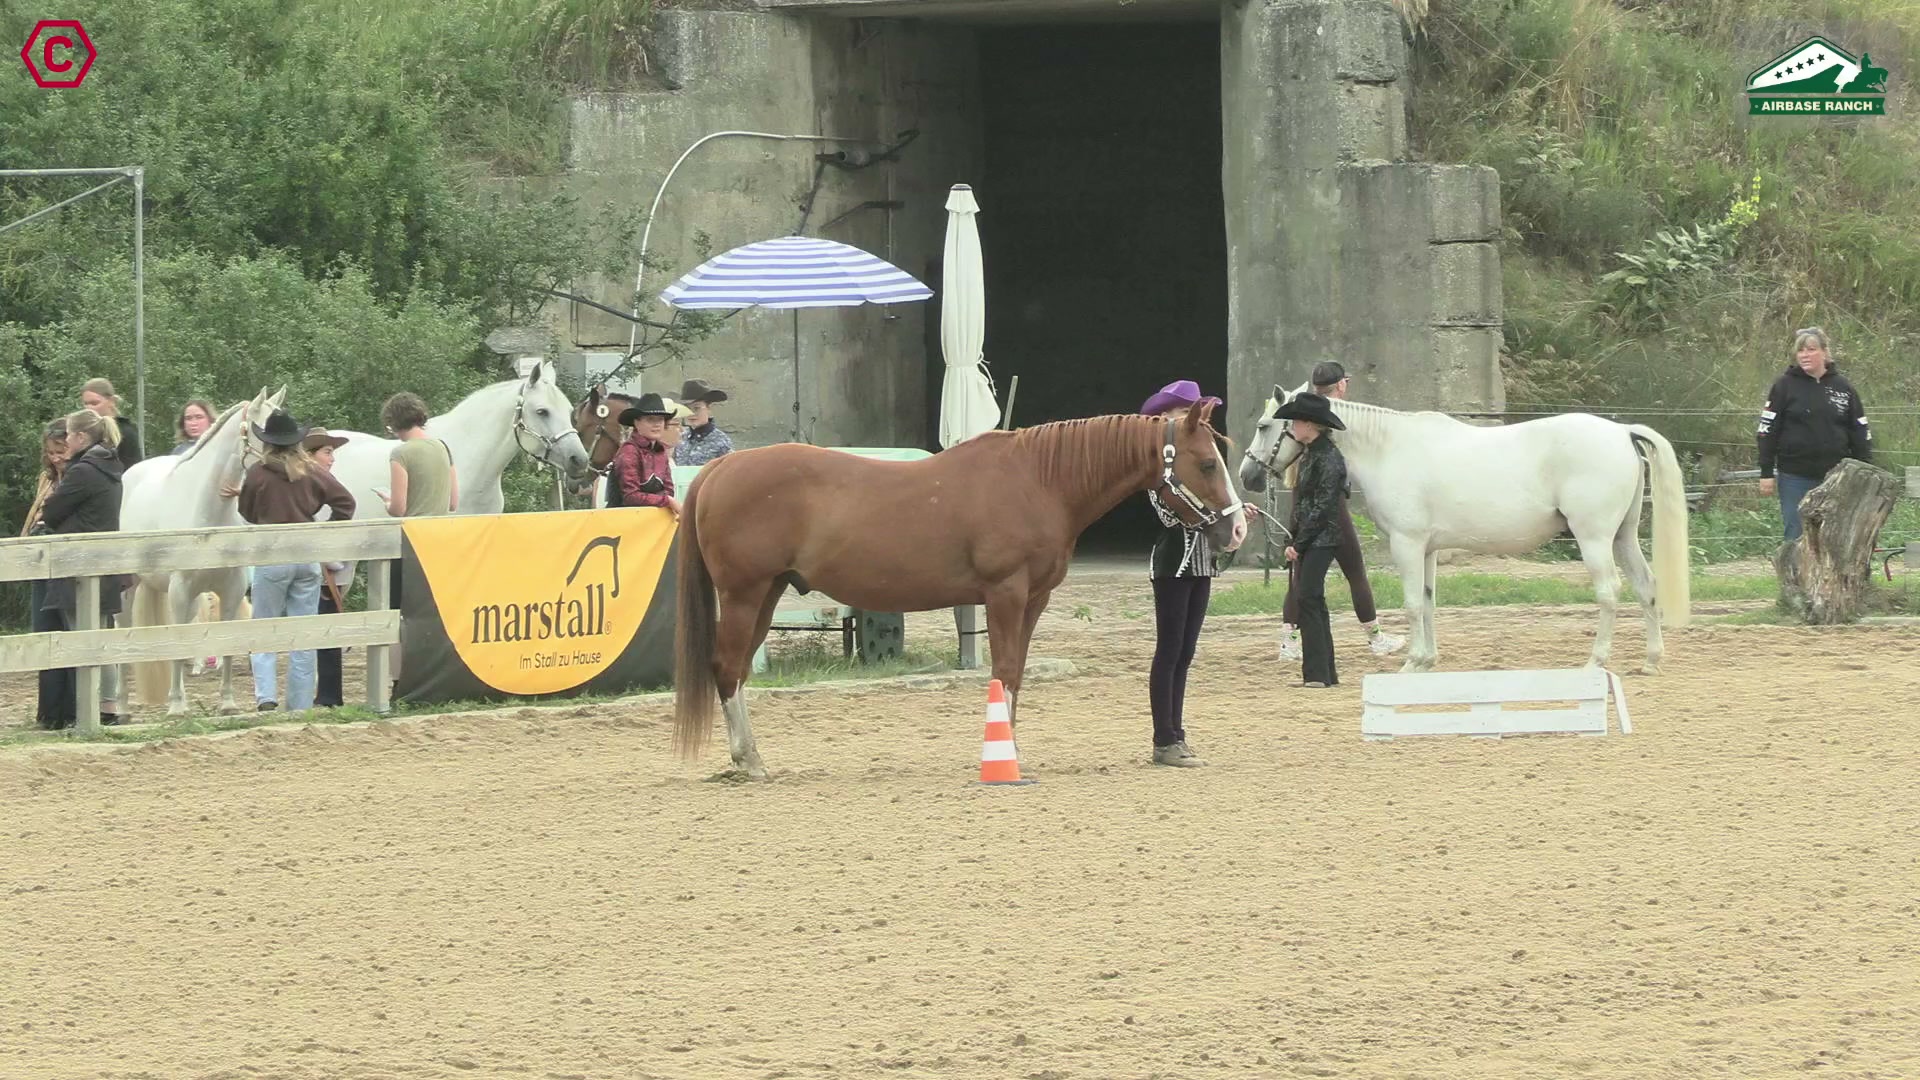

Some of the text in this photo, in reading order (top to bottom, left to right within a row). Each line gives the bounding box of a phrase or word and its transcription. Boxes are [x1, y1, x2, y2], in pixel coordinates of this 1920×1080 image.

[471, 583, 604, 644] marstall
[519, 650, 601, 670] Im Stall zu Hause
